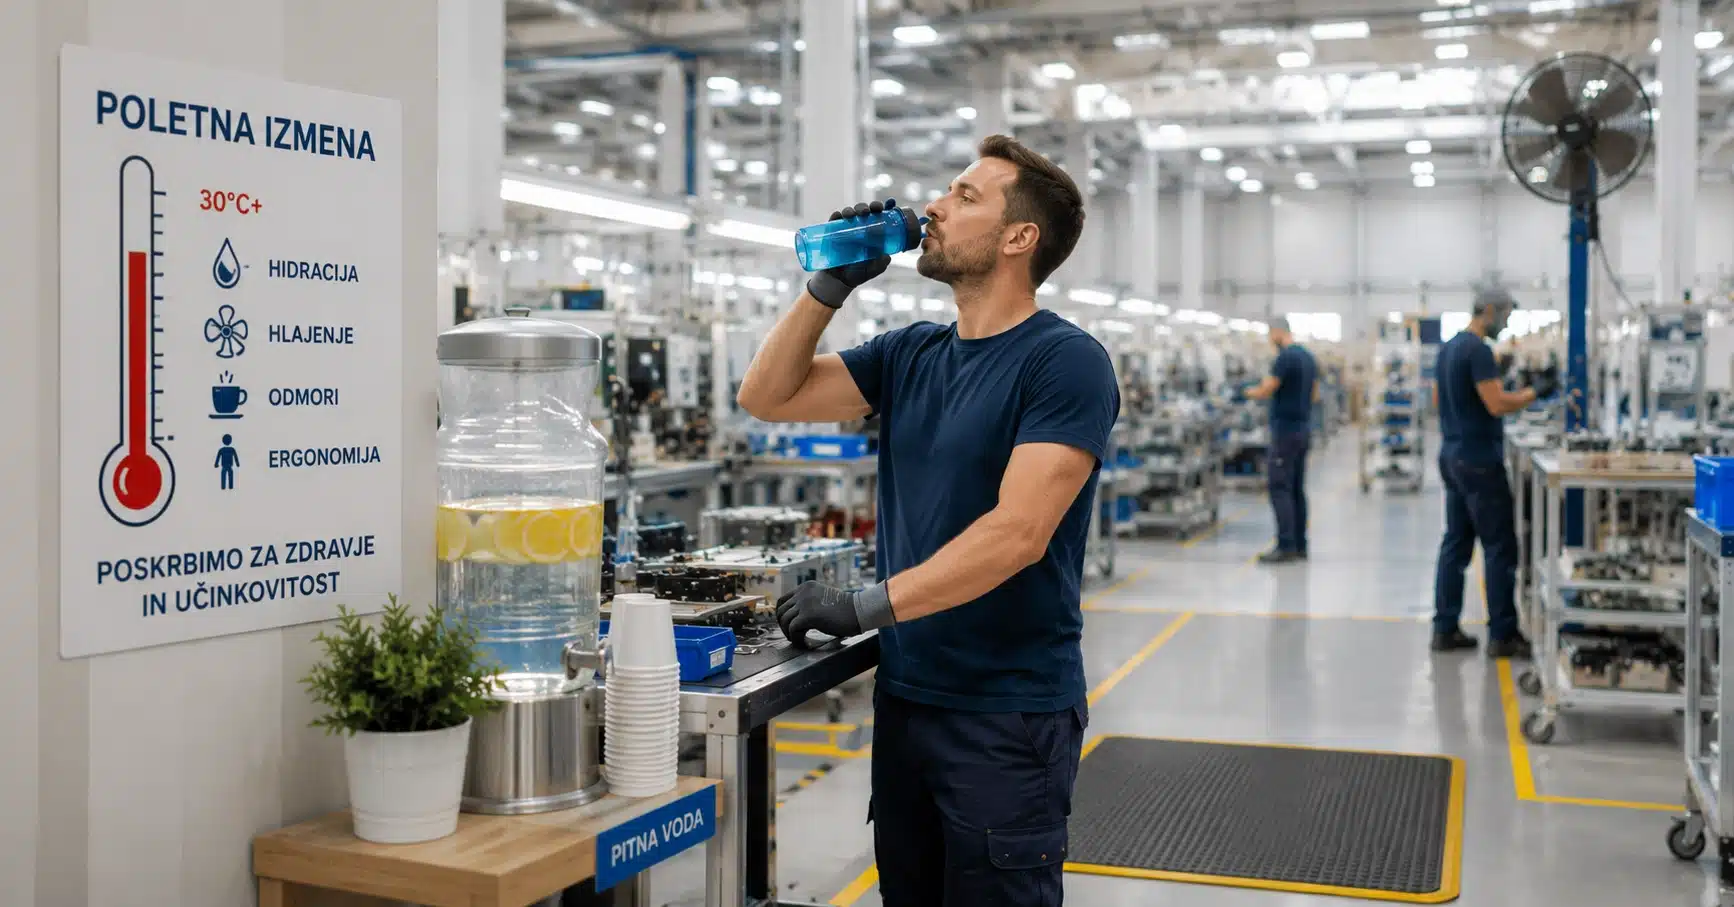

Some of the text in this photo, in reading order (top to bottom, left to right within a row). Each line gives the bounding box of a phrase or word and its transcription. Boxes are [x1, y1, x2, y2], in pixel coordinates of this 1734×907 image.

[97, 90, 376, 161] POLETNA IZMENA
[200, 189, 263, 214] 30°C+
[269, 259, 359, 283] HIDRACIJA
[269, 325, 354, 345] HLAJENJE
[269, 388, 339, 406] ODMORI
[269, 446, 381, 469] ERGONOMIJA
[98, 535, 376, 584] POSKRBIMO ZA ZDRAVJE
[143, 572, 341, 617] IN UČINKOVITOST
[611, 808, 704, 867] PITNA VODA
